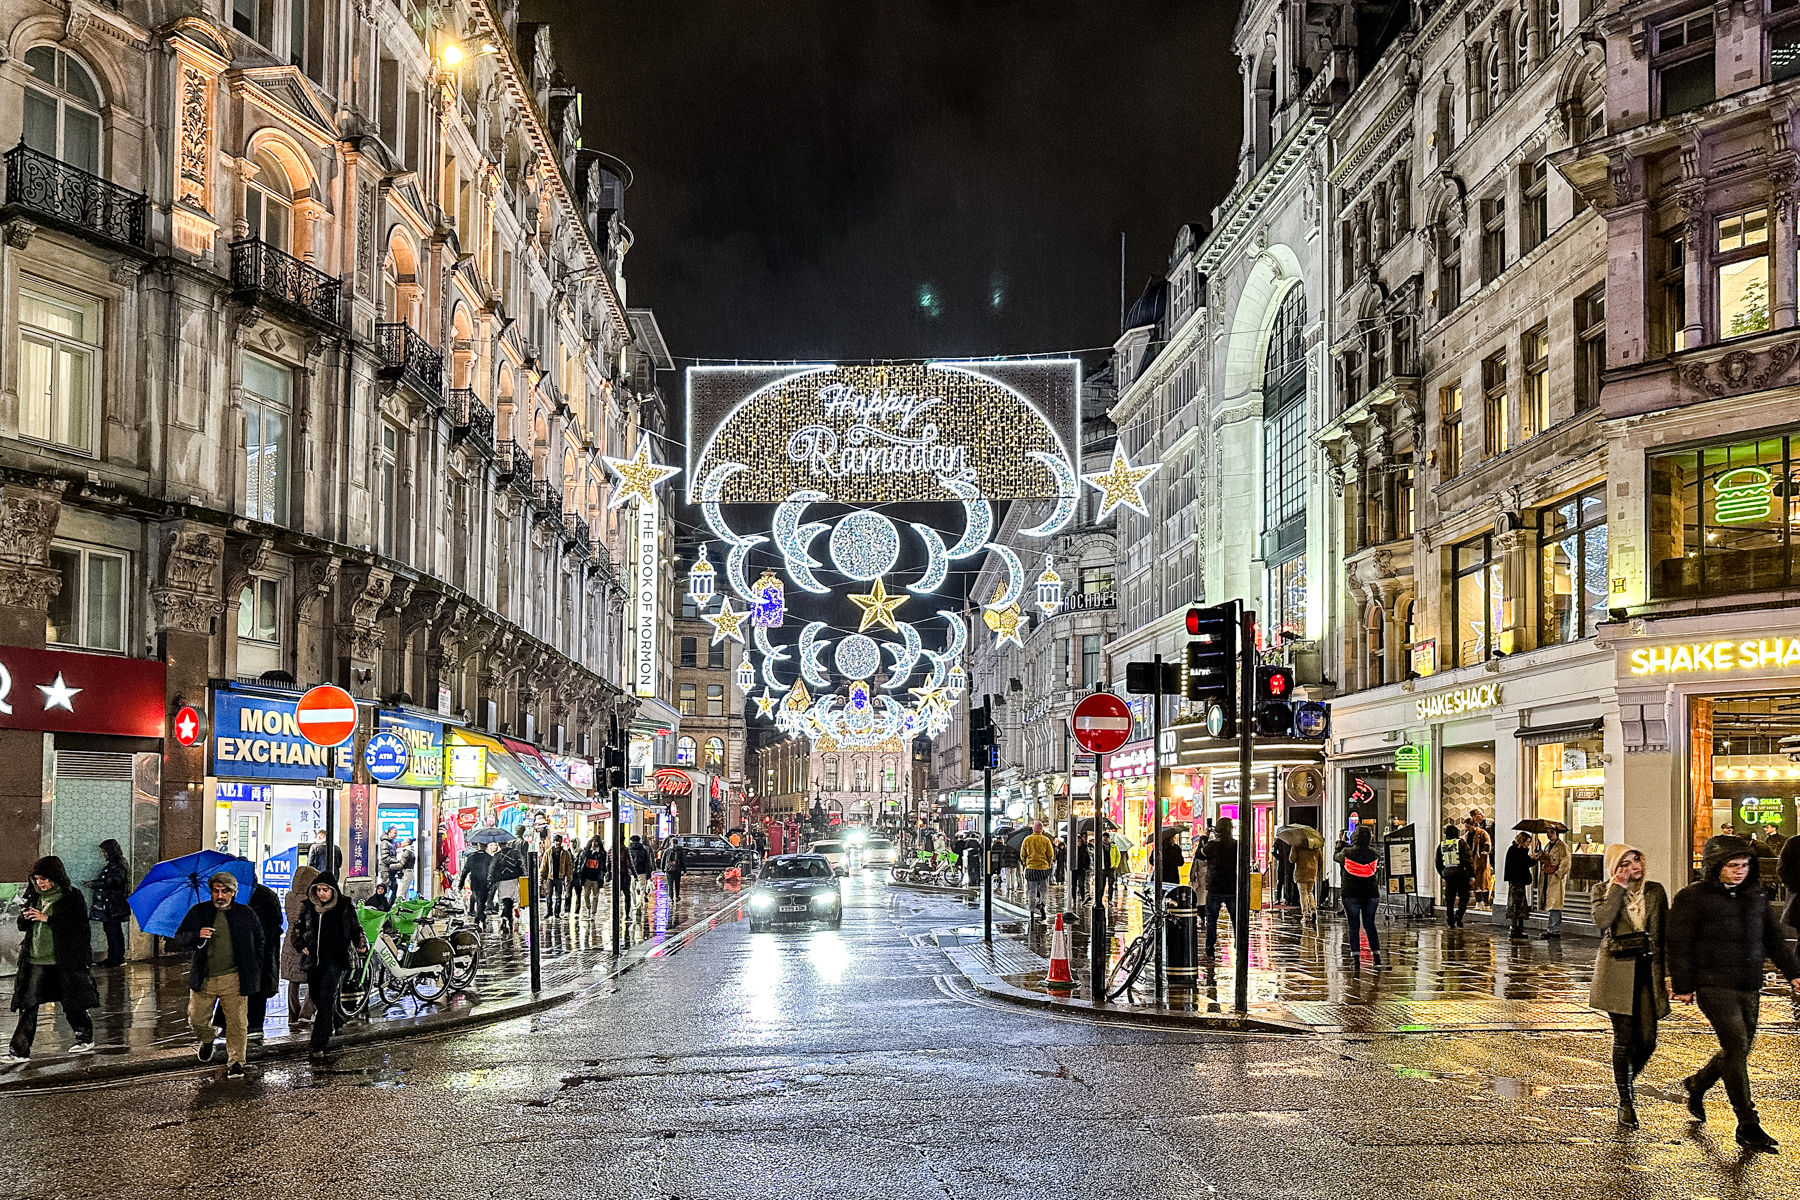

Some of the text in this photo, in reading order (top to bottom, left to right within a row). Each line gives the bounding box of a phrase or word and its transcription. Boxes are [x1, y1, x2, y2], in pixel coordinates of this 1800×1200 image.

[818, 384, 942, 430] Happy
[788, 424, 977, 480] Ramadan
[640, 511, 654, 685] THE BOOK OF MORMON
[1631, 642, 1734, 675] SHAKE
[1416, 683, 1497, 720] SHAKE SHACK
[241, 707, 300, 737] MON
[366, 735, 406, 766] CHANGE
[447, 748, 455, 783] OPEN
[372, 765, 401, 774] MONEY
[658, 775, 689, 796] Happy
[1760, 811, 1782, 823] Ale
[265, 860, 290, 873] ATM
[379, 946, 397, 968] Lime
